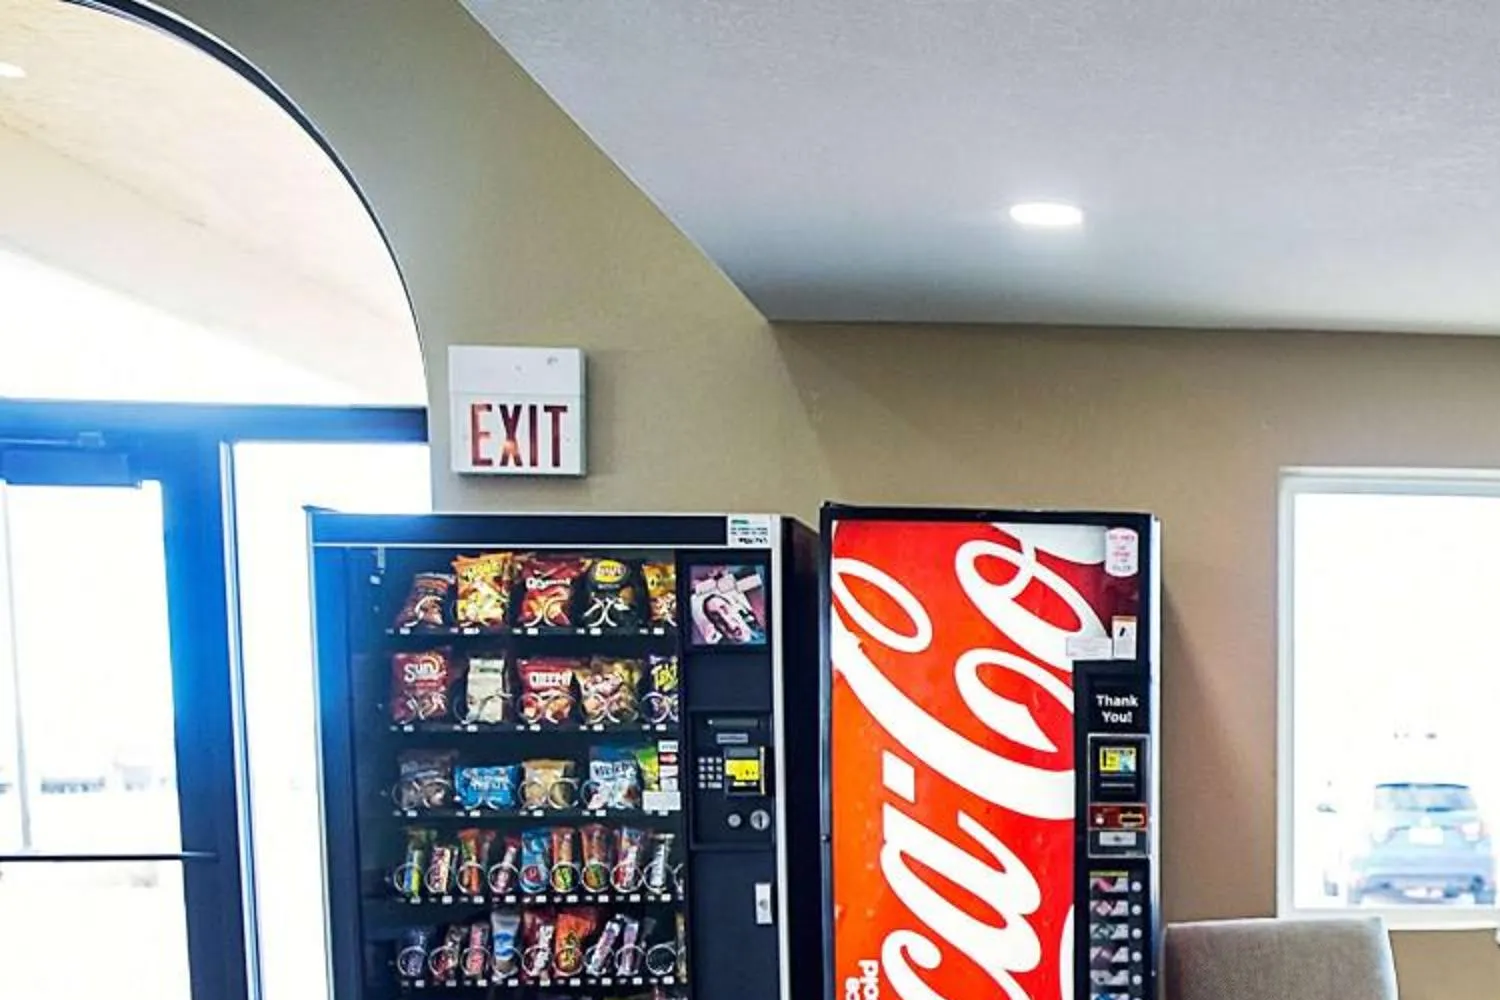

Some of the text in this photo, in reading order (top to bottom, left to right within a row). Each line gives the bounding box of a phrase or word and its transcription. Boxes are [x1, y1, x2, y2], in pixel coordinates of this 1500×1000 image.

[470, 403, 568, 467] EXIT
[1096, 694, 1139, 708] Thank
[1101, 710, 1133, 724] You!
